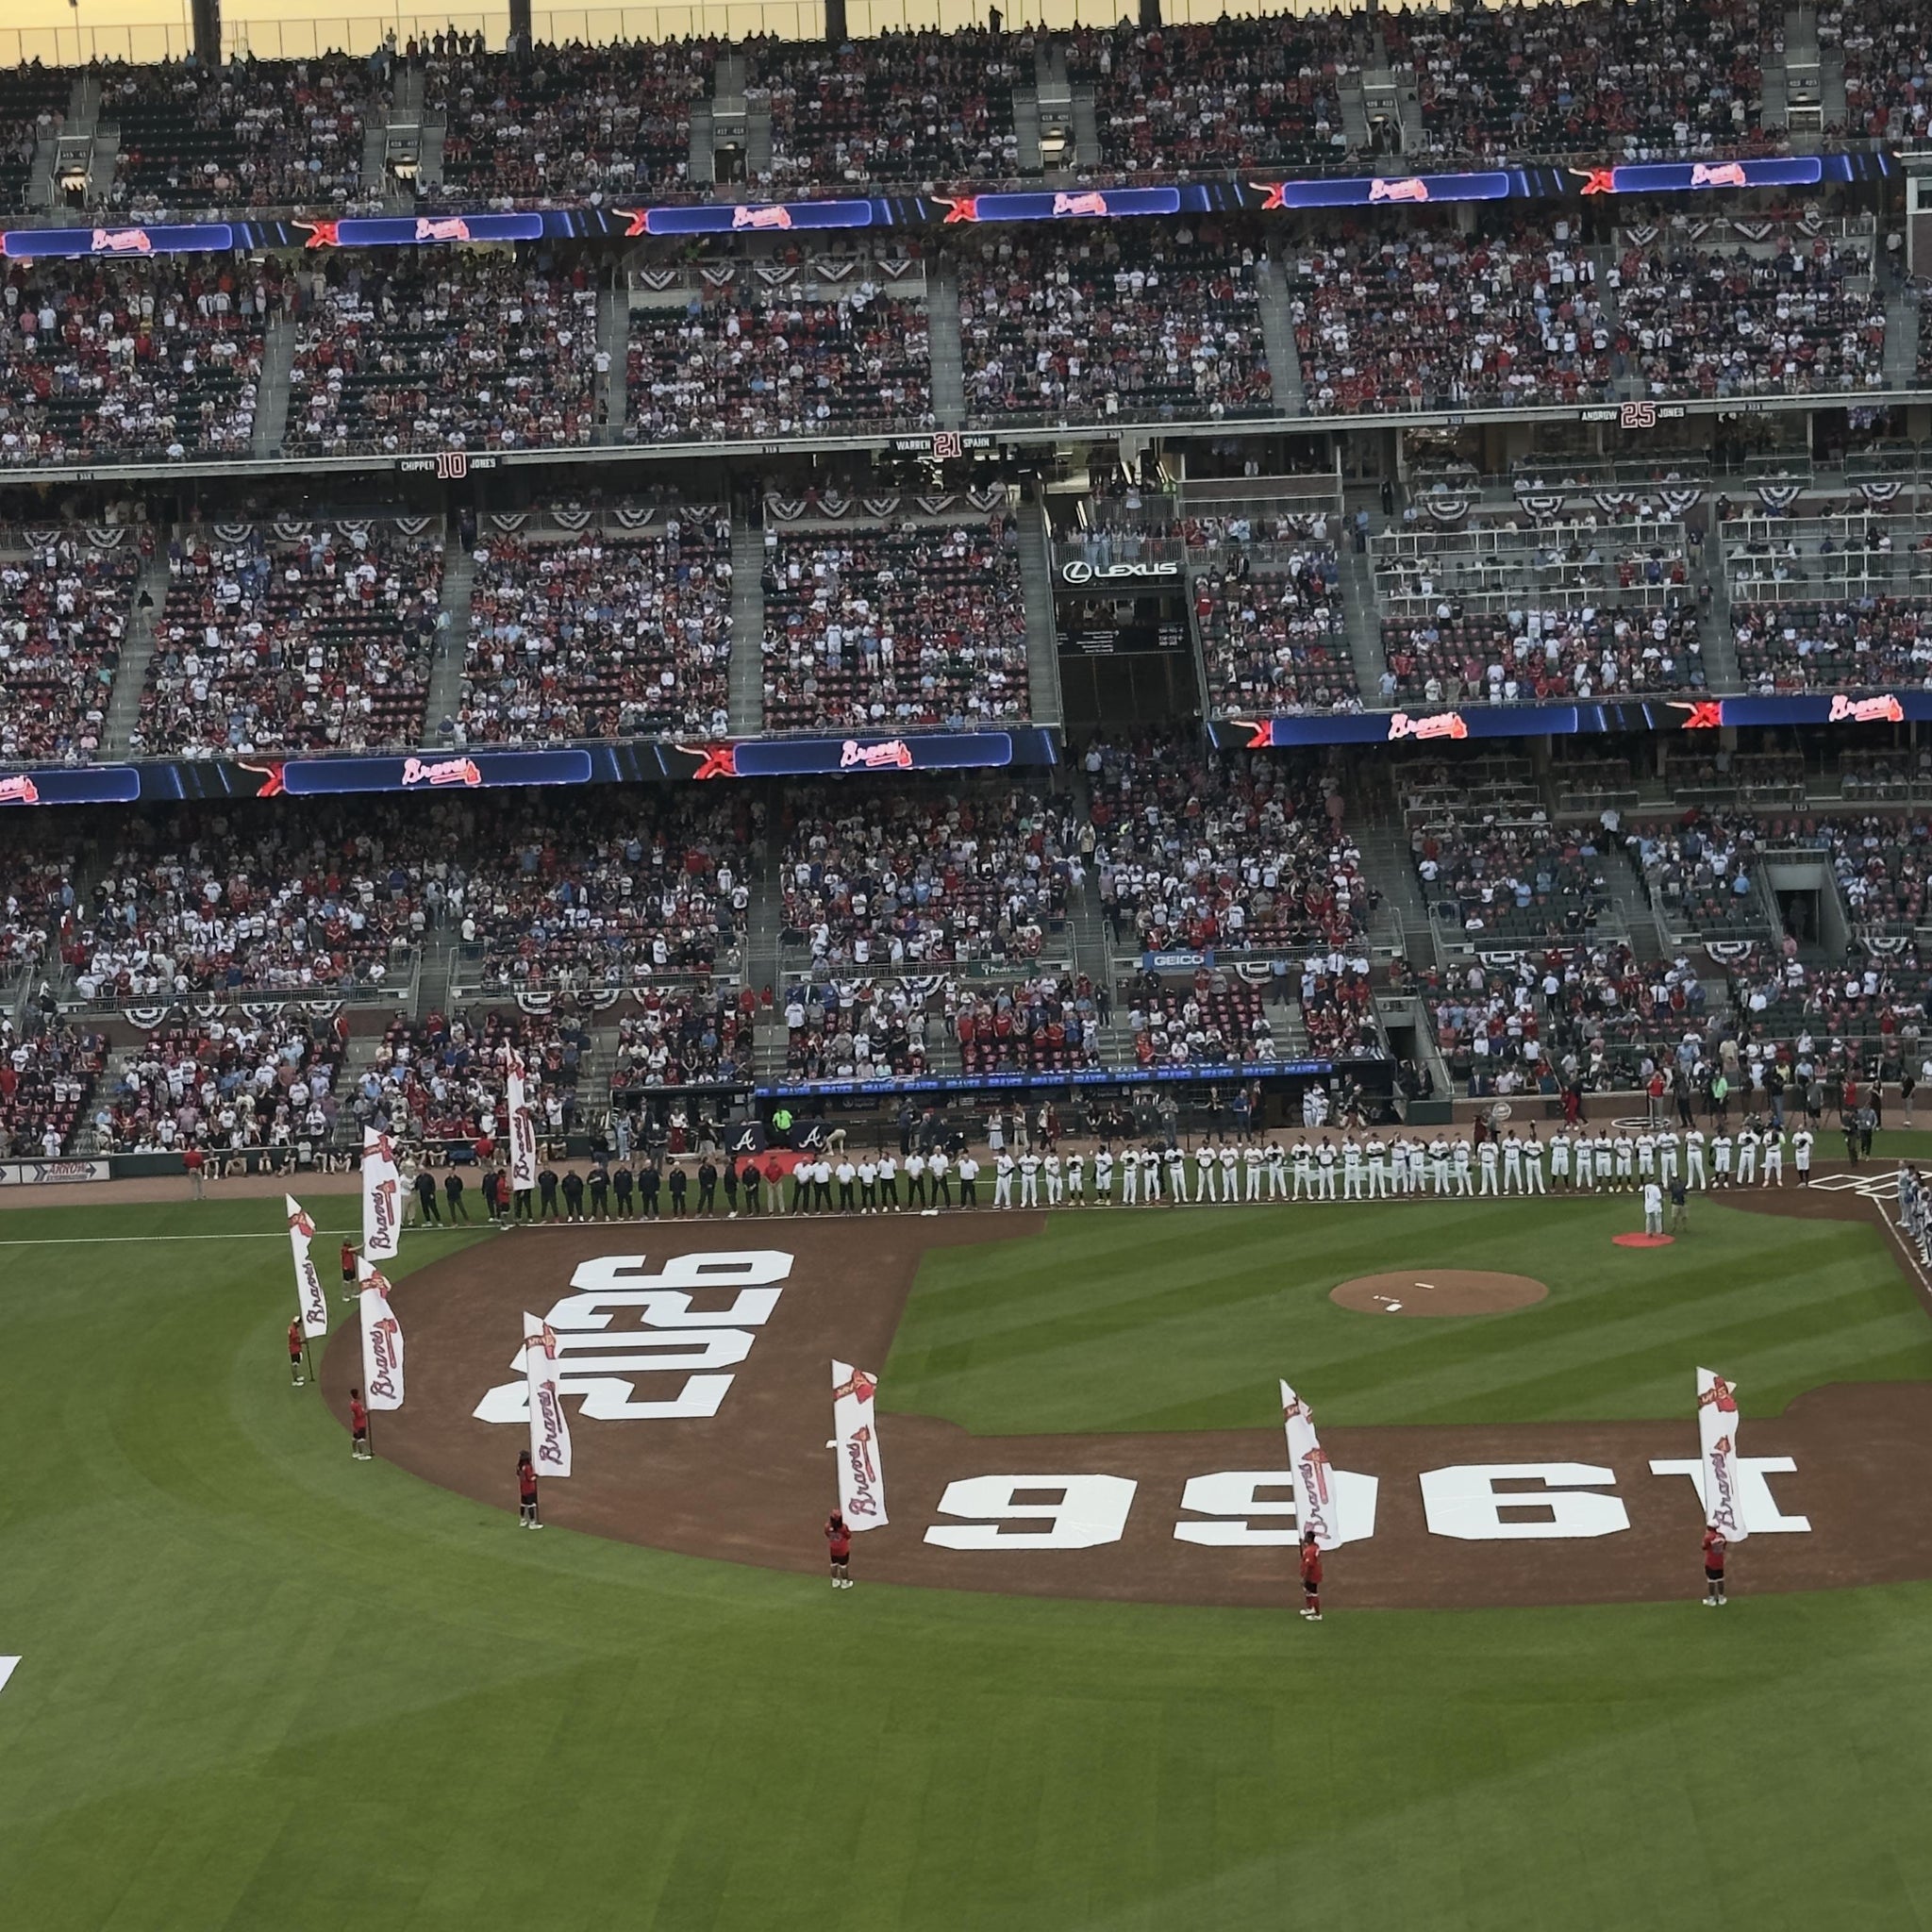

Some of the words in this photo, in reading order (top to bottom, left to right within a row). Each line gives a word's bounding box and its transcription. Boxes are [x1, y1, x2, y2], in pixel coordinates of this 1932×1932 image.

[896, 440, 931, 450] WARREN
[933, 431, 962, 458] 21
[963, 438, 990, 448] SPAHN
[1621, 401, 1656, 428] 25
[1657, 408, 1684, 418] JONES
[401, 460, 434, 471] CHIPPER
[437, 452, 466, 478] 10
[470, 458, 495, 469] JONES
[1094, 562, 1177, 577] LEXUS
[1154, 955, 1205, 966] GEICO
[369, 1191, 391, 1250] Braves
[302, 1262, 326, 1324] Braves
[370, 1330, 396, 1400] Braves
[538, 1391, 563, 1465] Braves
[847, 1442, 877, 1516] Braves
[1298, 1463, 1331, 1540] Braves
[1710, 1453, 1737, 1531] Braves
